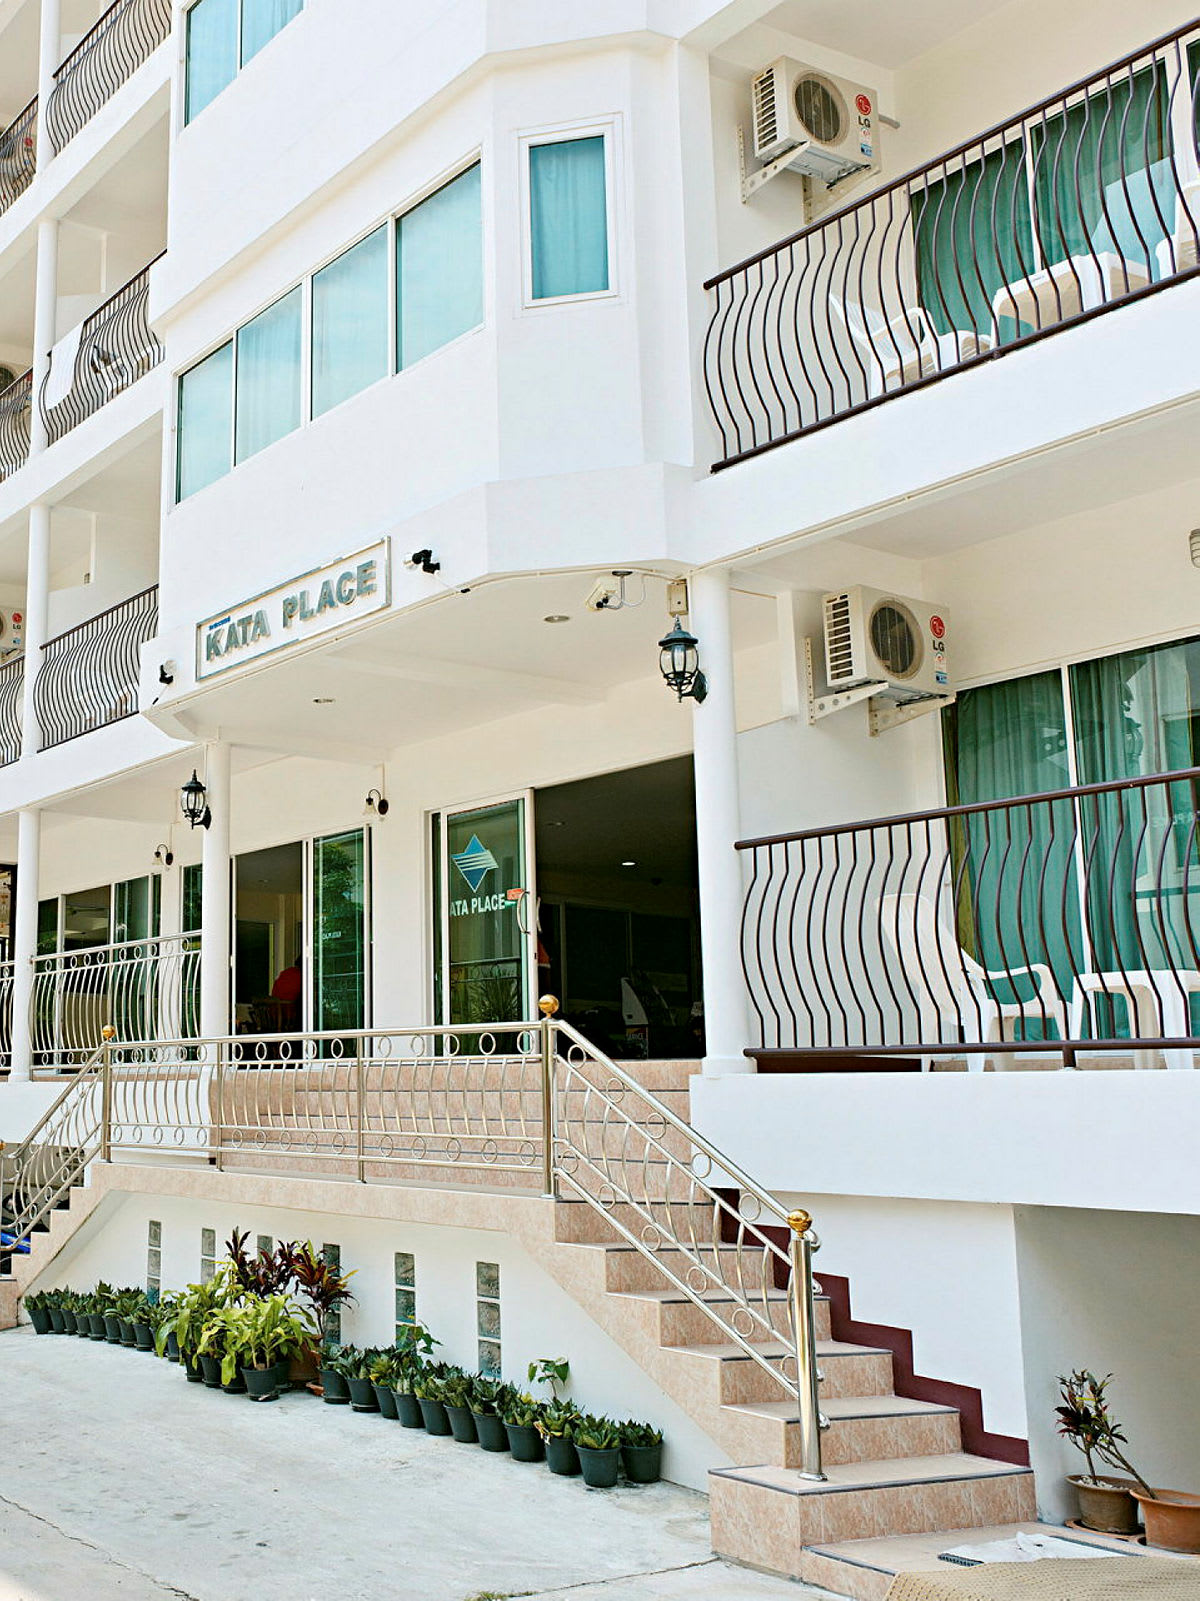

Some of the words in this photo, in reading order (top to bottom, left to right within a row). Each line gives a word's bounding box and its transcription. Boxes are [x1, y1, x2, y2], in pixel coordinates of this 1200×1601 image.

[858, 115, 871, 128] LG
[206, 610, 271, 662] KATA
[282, 560, 378, 629] PLACE
[932, 640, 945, 652] LG
[450, 899, 469, 917] ATA
[471, 893, 506, 914] PLACE
